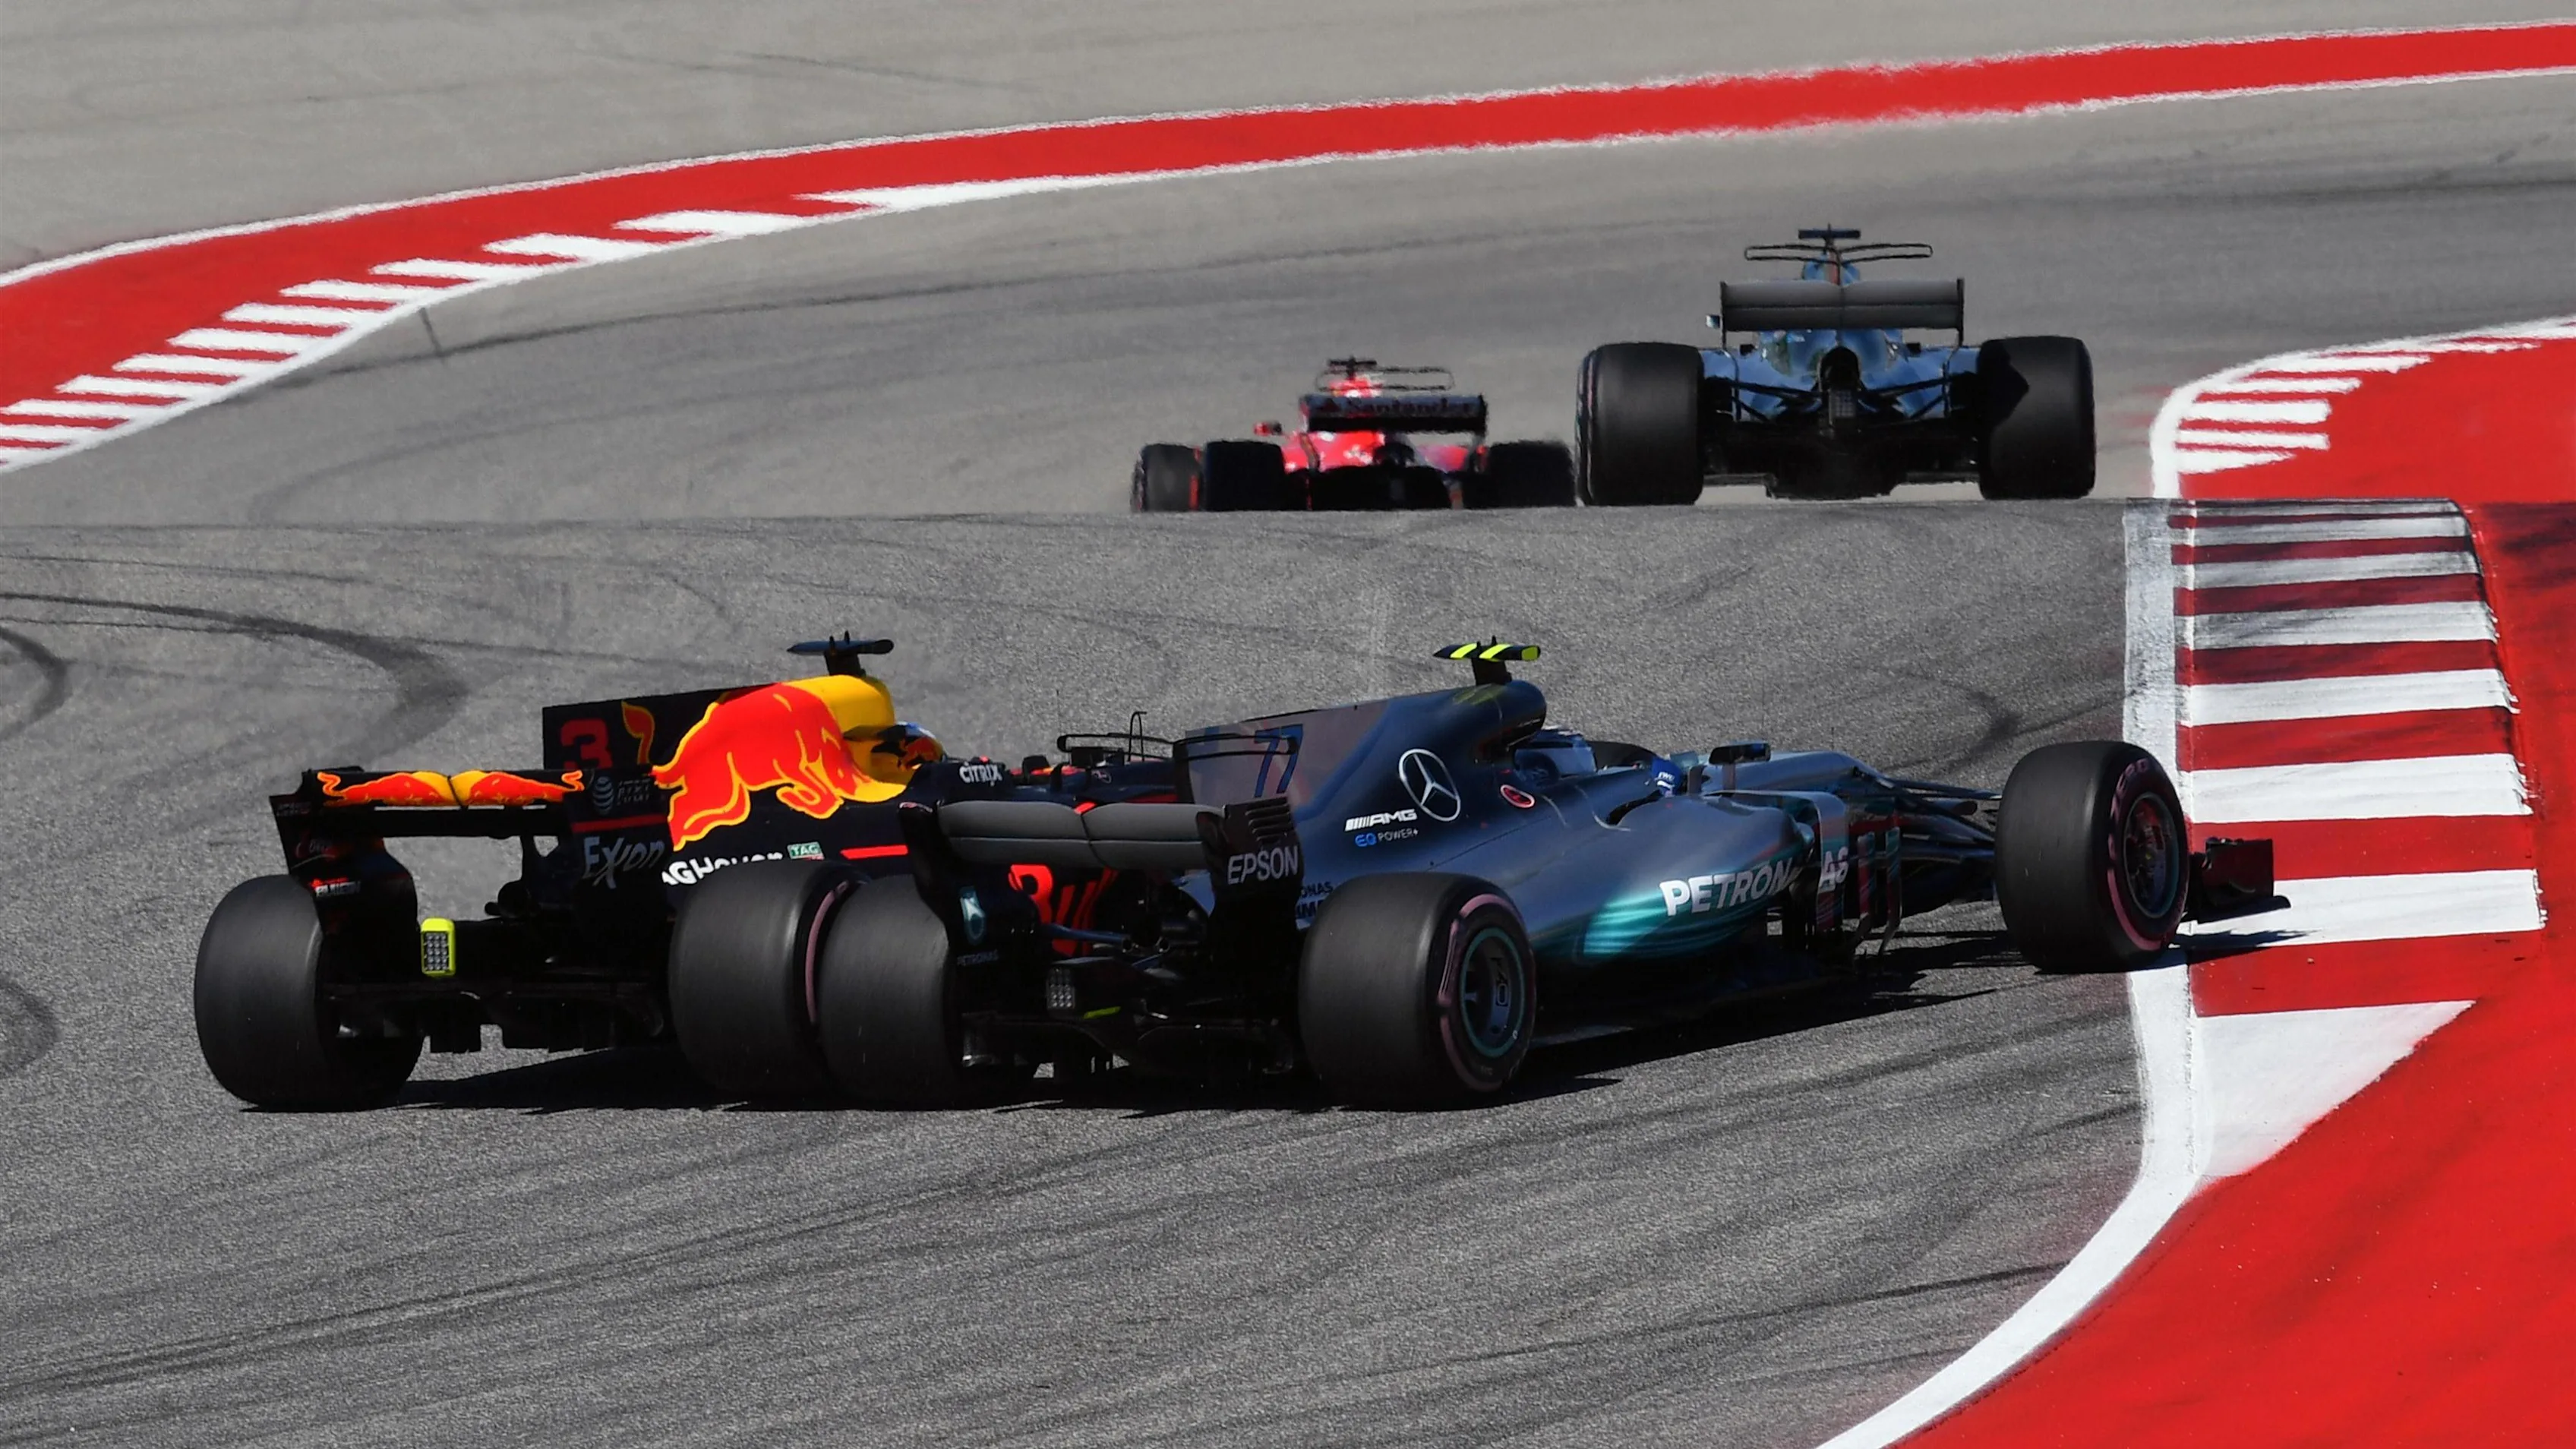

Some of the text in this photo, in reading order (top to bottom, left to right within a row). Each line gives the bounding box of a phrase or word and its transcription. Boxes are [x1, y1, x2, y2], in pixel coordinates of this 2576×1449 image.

[560, 717, 613, 769] 3
[1254, 723, 1304, 797] 77
[1368, 807, 1419, 827] AMG
[791, 844, 819, 857] TAG
[1226, 844, 1299, 885] EPSON
